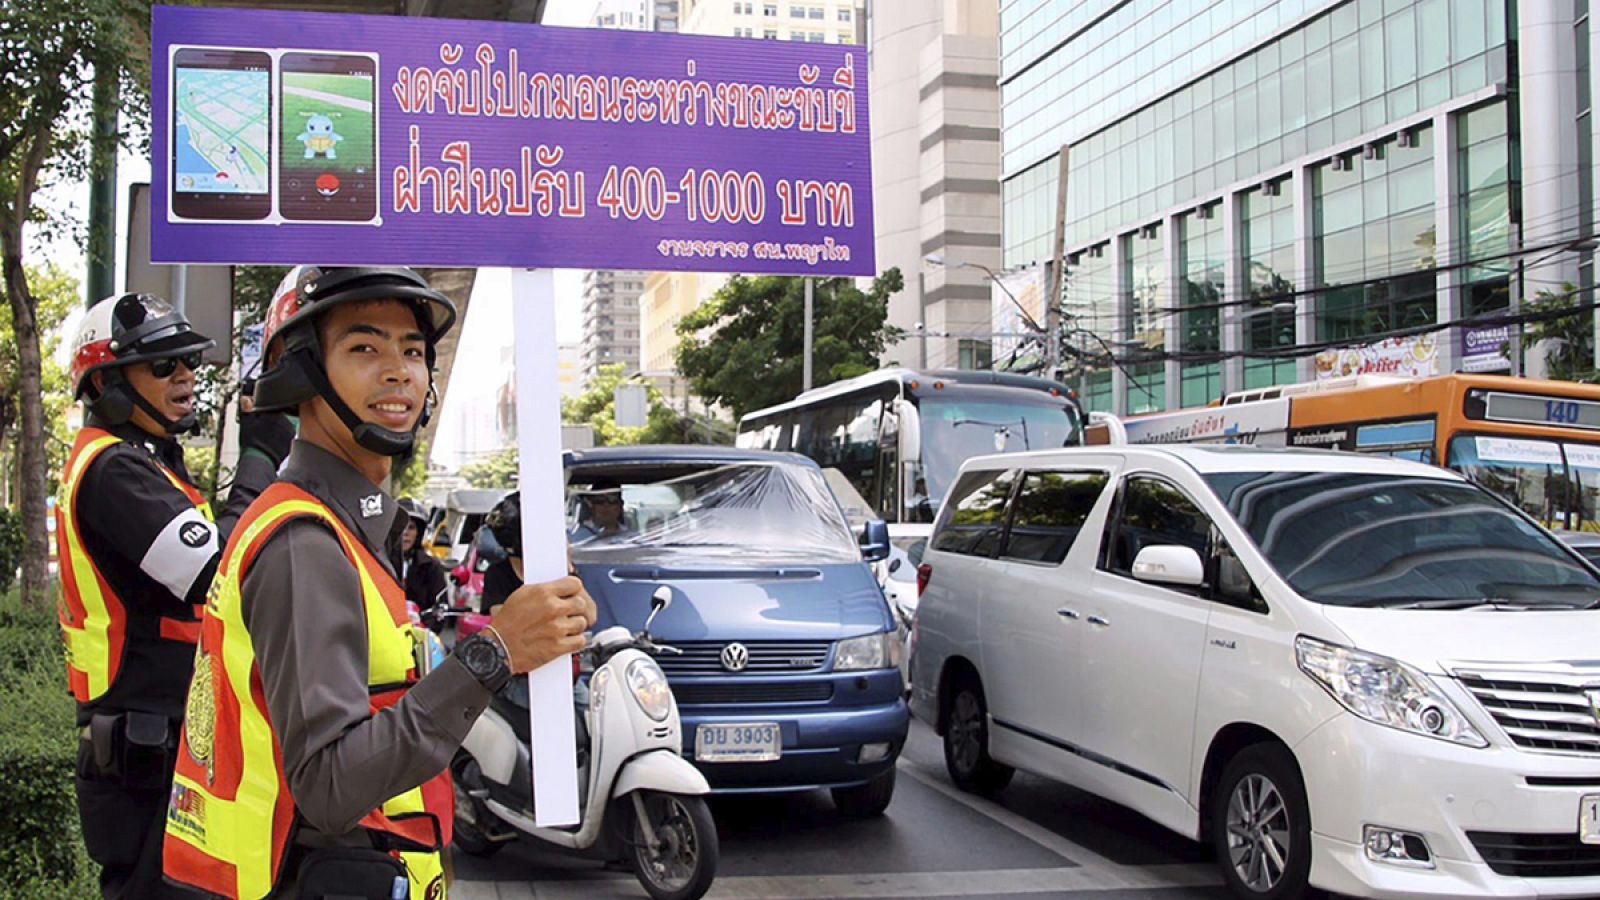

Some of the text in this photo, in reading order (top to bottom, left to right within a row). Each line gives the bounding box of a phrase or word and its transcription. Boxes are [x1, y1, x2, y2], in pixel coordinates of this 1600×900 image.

[392, 43, 856, 133] งดจับโปเกมอนระหว่างขณะขับขี่
[394, 125, 853, 227] ฝ่าฝืนปรับ 400-1000 บาท
[657, 235, 850, 265] งานจราจร สน.พญาไท
[1544, 400, 1579, 423] 140
[733, 727, 773, 744] 3903
